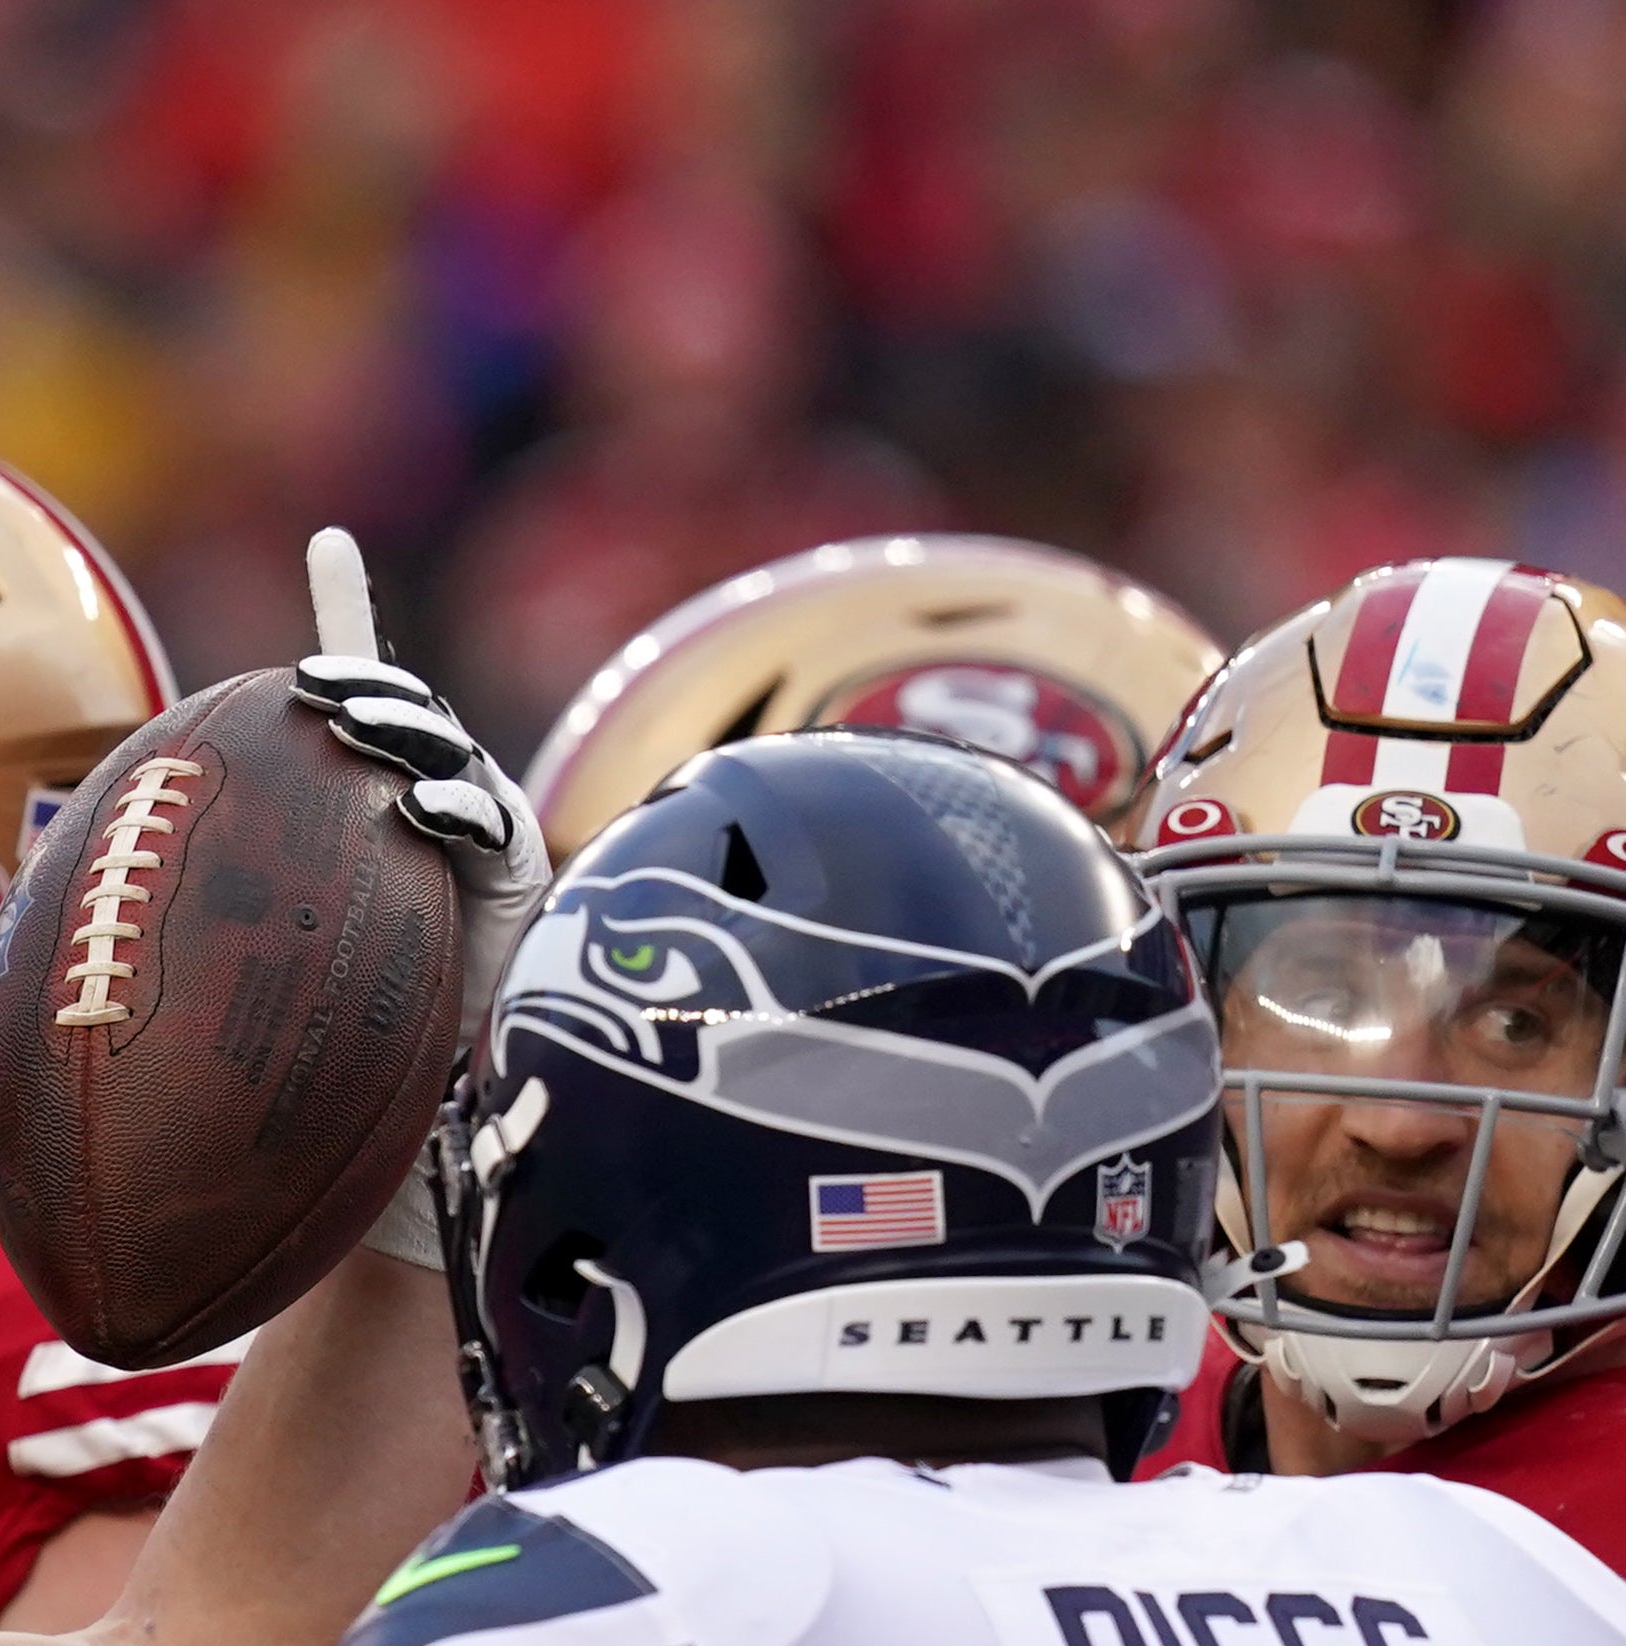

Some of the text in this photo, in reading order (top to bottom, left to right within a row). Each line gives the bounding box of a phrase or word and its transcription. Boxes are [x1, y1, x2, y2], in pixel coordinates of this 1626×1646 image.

[323, 863, 378, 996] FOOTBALL
[1106, 1199, 1143, 1233] NFL
[838, 1315, 1166, 1347] SEATTLE
